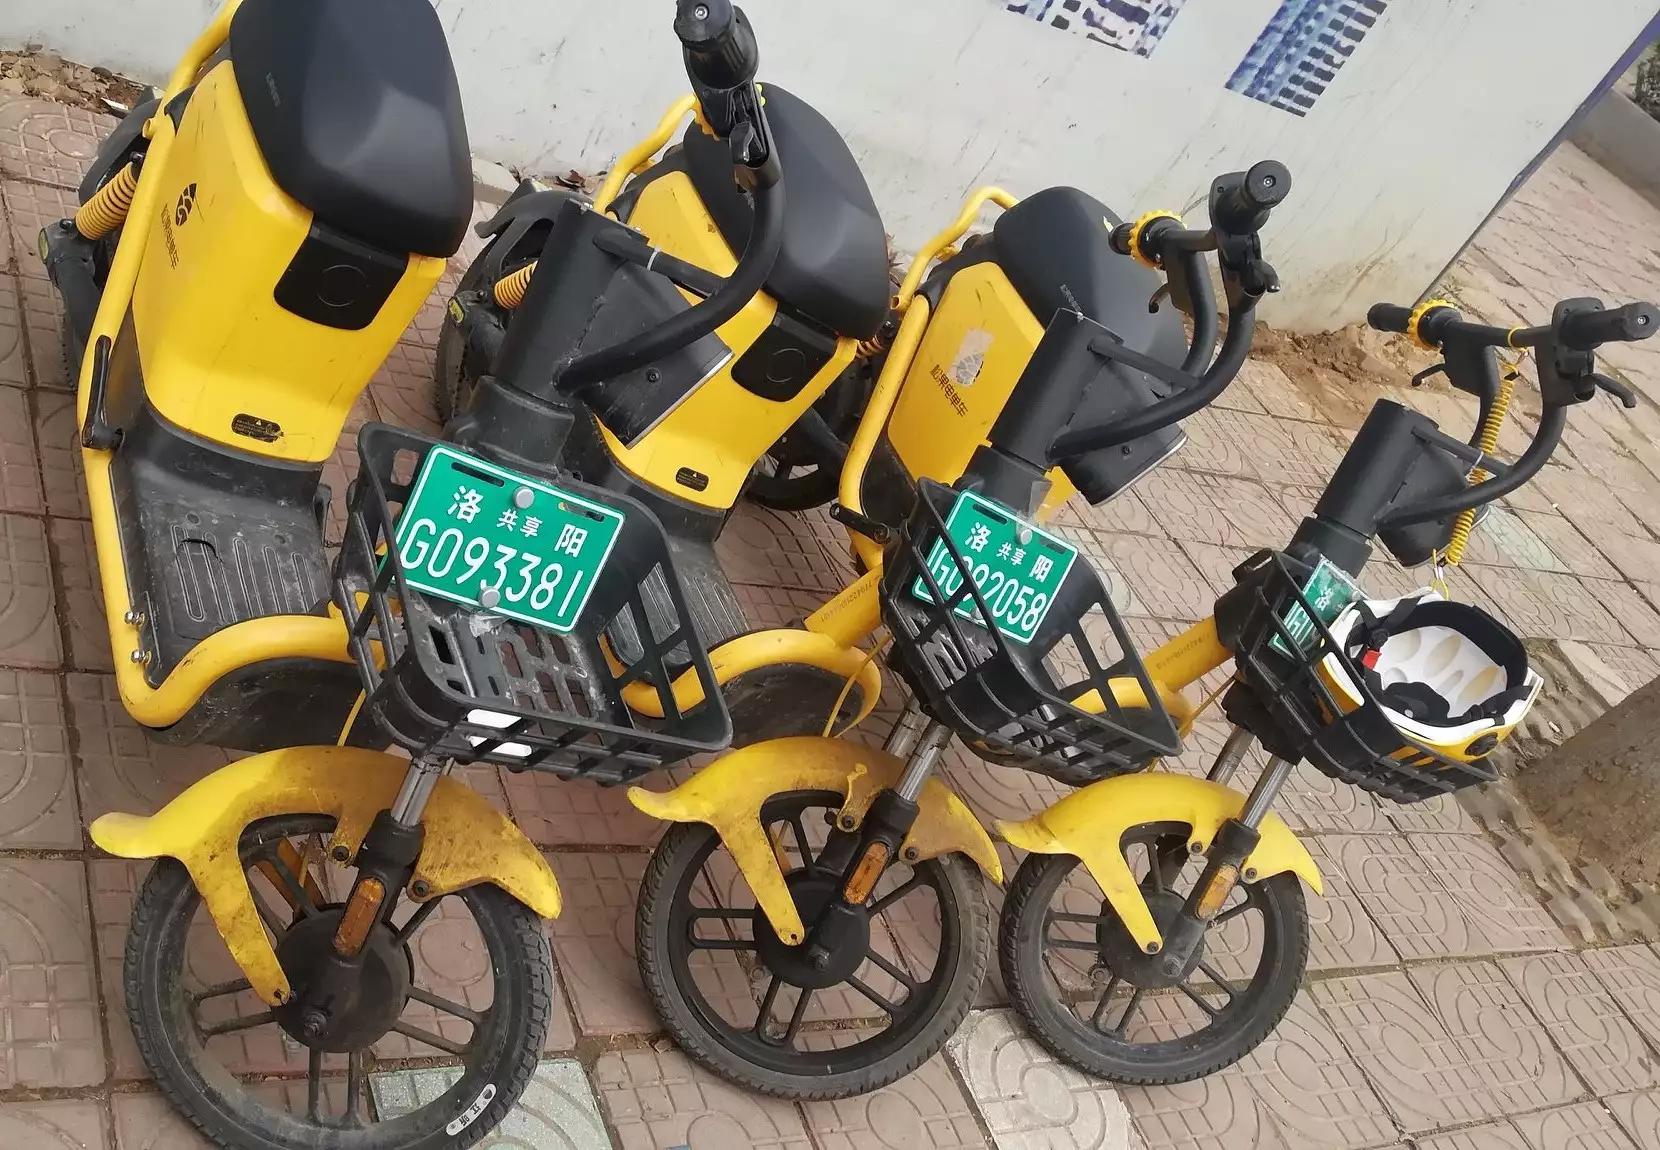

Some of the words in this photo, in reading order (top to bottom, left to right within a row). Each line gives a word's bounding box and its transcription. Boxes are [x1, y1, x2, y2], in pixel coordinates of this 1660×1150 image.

[448, 485, 484, 524] 洛
[496, 508, 543, 538] 共享
[554, 523, 588, 558] 阳
[996, 542, 1027, 566] 共享
[400, 518, 584, 618] G093381
